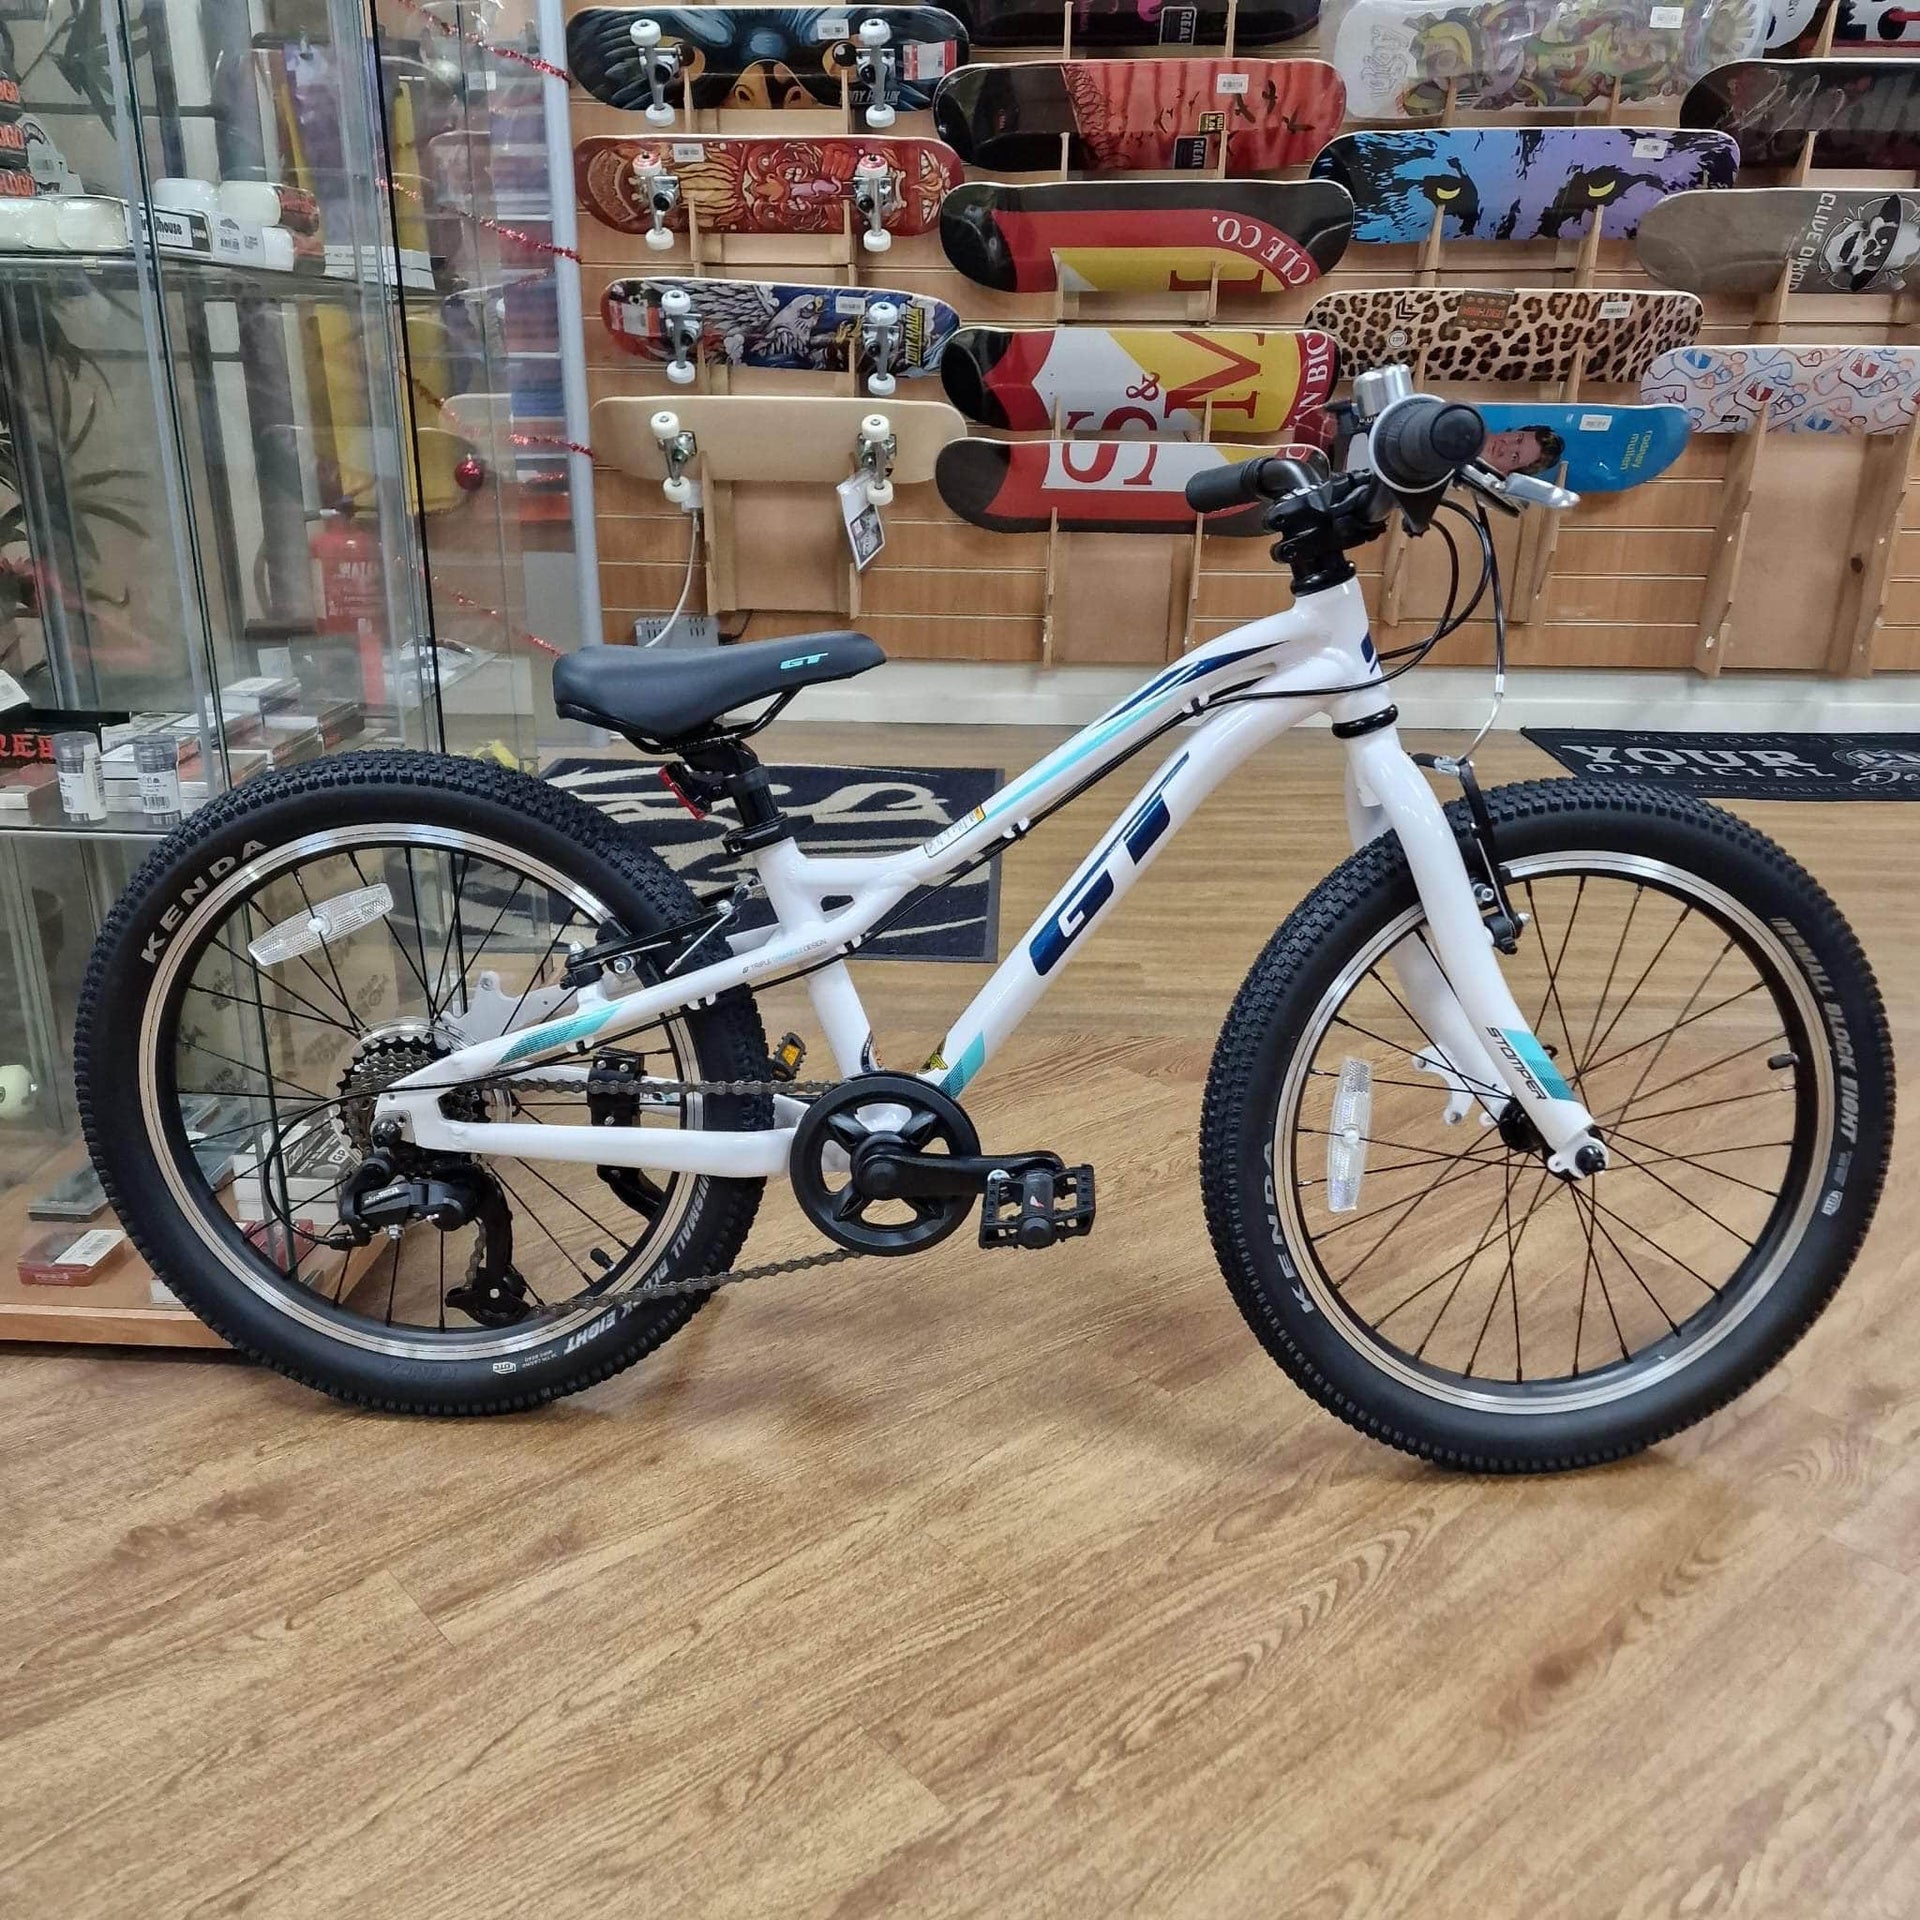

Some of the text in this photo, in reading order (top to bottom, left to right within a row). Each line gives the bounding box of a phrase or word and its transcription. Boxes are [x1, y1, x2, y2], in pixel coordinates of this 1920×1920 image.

[1180, 11, 1192, 41] REAL
[1192, 140, 1204, 167] REAL
[1806, 192, 1837, 242] CLIVE
[780, 652, 829, 670] GT
[1560, 745, 1817, 767] YOUR
[1586, 763, 1837, 777] OFFICIAL
[1029, 751, 1190, 976] GT
[140, 839, 268, 964] KENDA
[1485, 1026, 1548, 1100] STOMPER
[1263, 1141, 1315, 1314] KENDA
